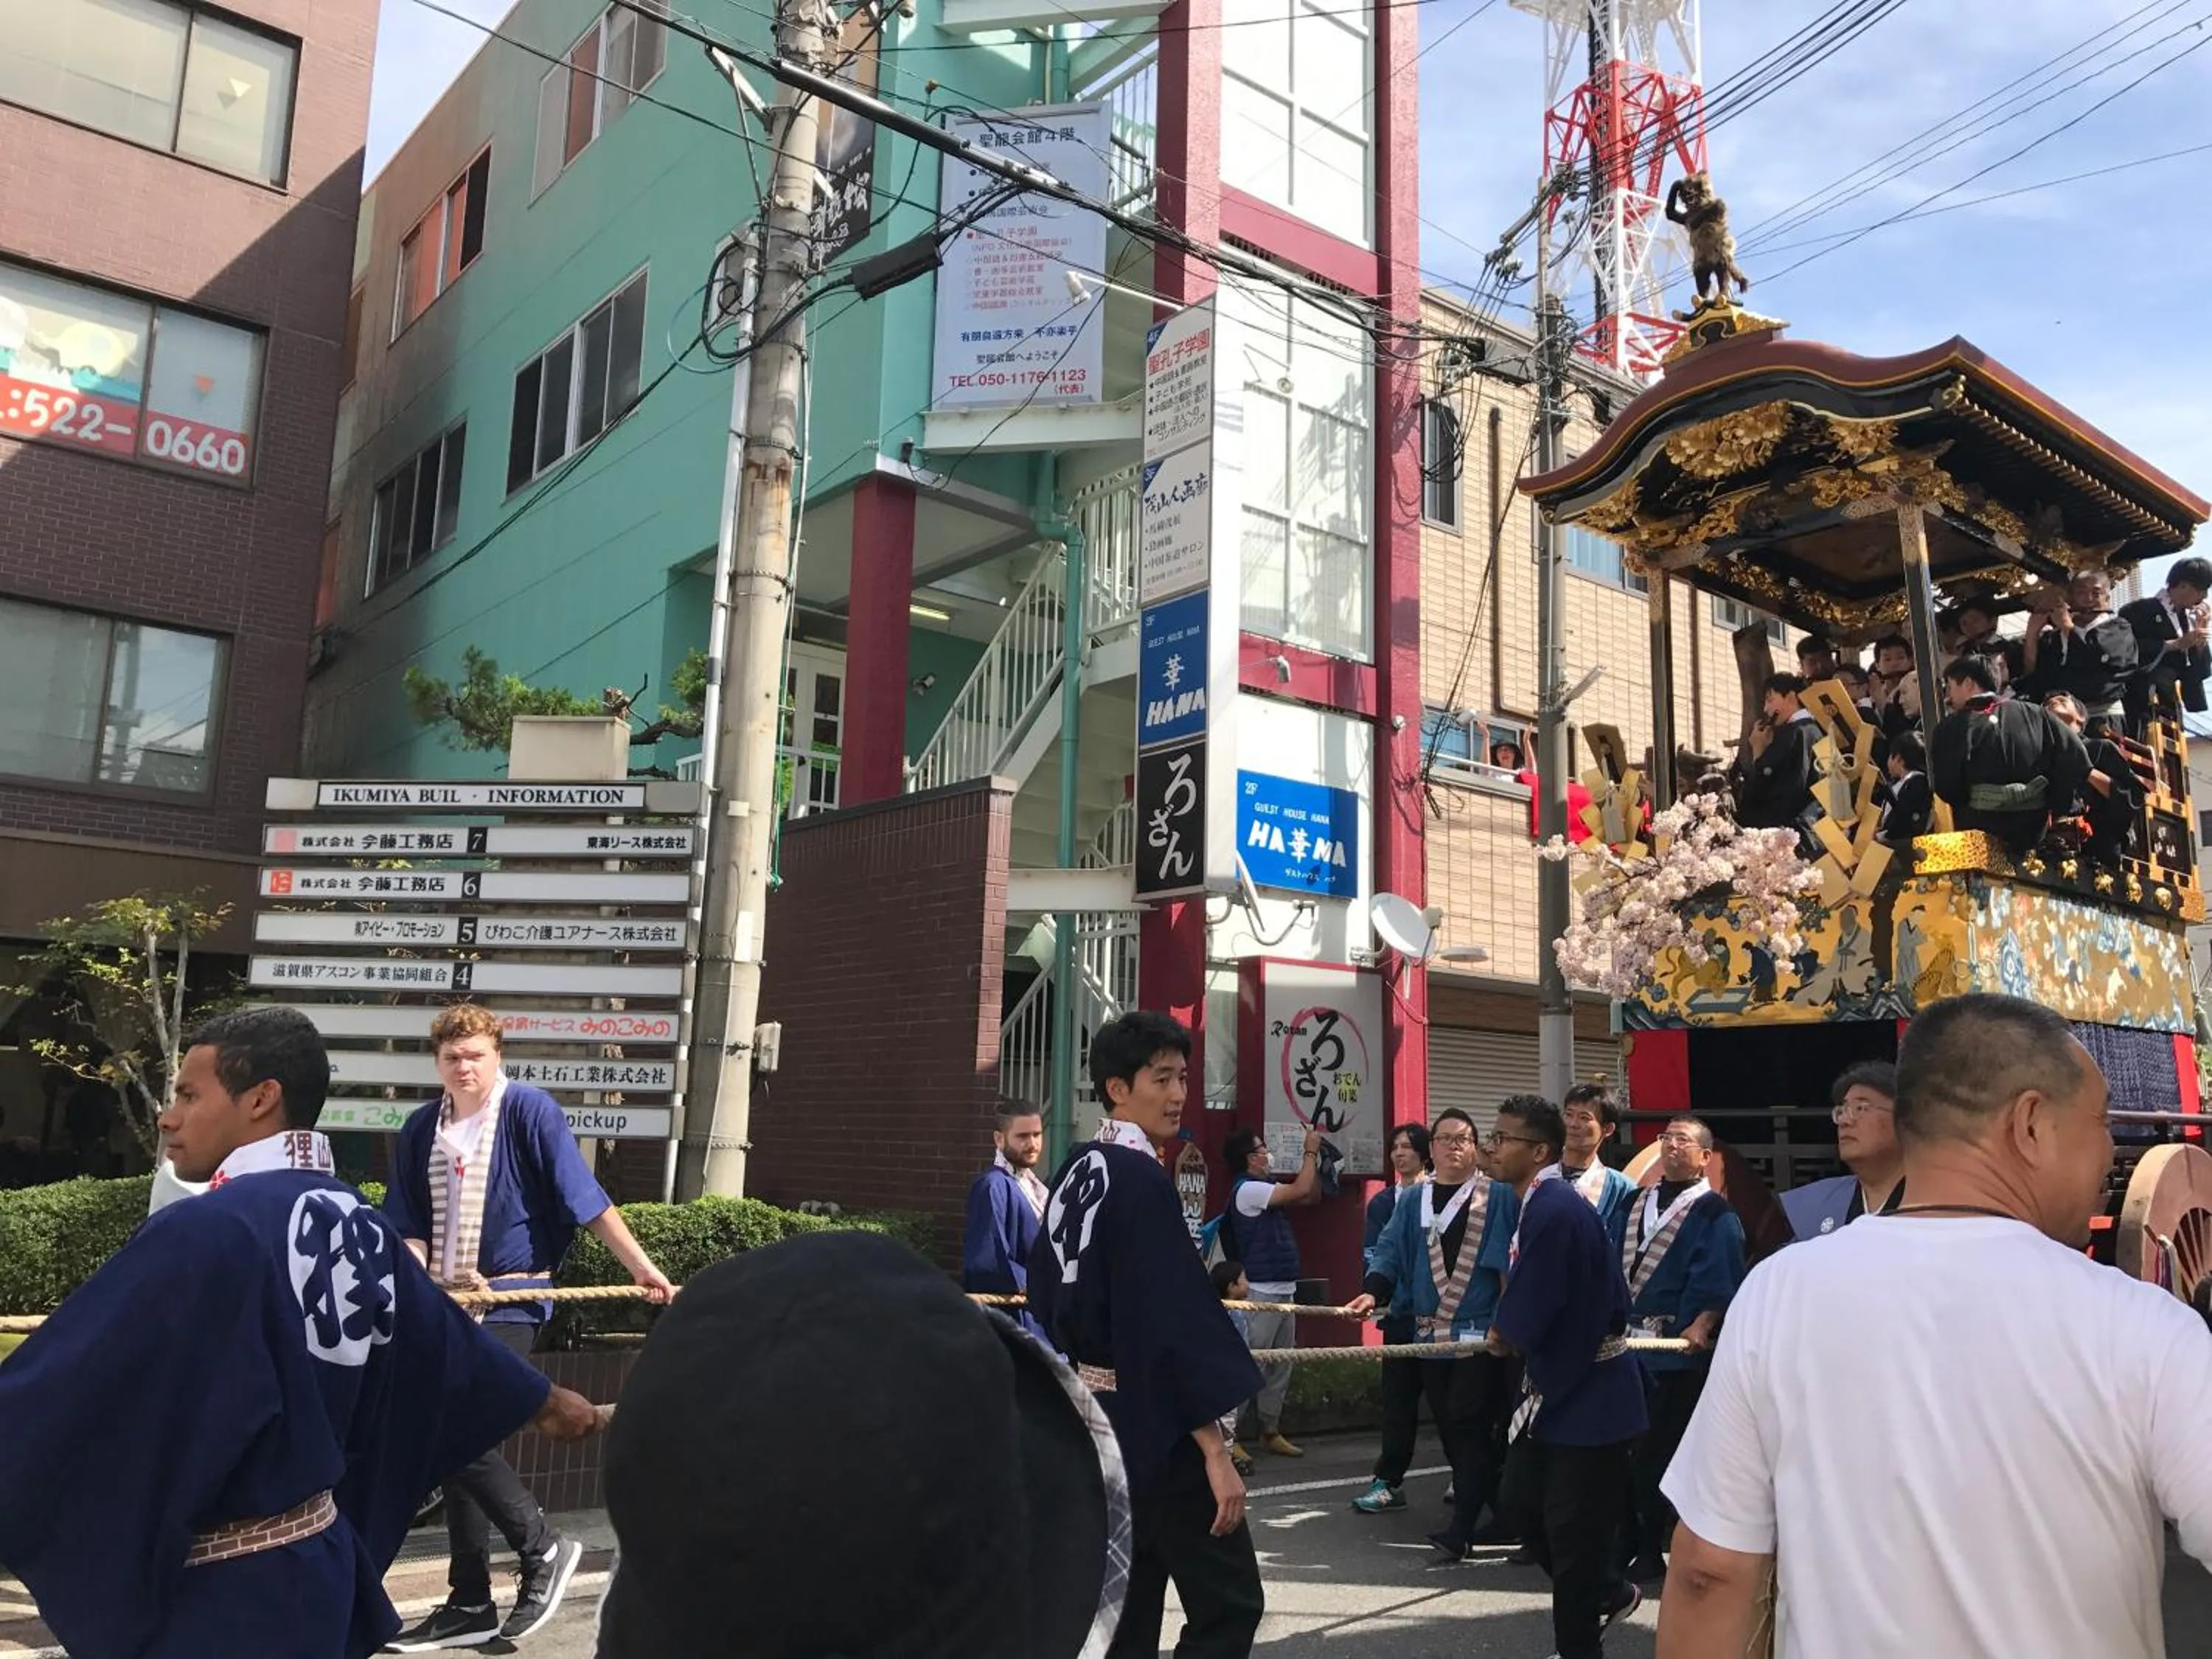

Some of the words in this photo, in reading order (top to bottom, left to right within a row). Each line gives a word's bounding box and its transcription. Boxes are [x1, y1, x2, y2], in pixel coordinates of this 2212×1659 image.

[1162, 653, 1185, 692] 華
[1145, 687, 1206, 728] HANA
[333, 788, 410, 802] IKUMIYA
[418, 789, 462, 803] BUIL
[488, 789, 625, 804] INFORMATION
[1148, 753, 1197, 880] ろざん
[1254, 802, 1279, 815] GUEST
[302, 835, 355, 848] 株式会社
[471, 832, 484, 850] 7
[587, 836, 686, 849] 東海リース株式会社
[301, 877, 352, 889] 株式会社
[463, 877, 477, 896] 6
[459, 922, 474, 942] 5
[484, 925, 678, 942] びわこ介護ユアナース株式会社
[271, 962, 448, 982] 滋賀県アスコン事業協同組合
[455, 967, 470, 986] 4
[579, 1017, 672, 1037] みのこみの
[1294, 1009, 1346, 1133] ろざん
[1333, 1072, 1362, 1087] おでん
[364, 1103, 410, 1127] こみ
[1180, 1172, 1206, 1194] HANA
